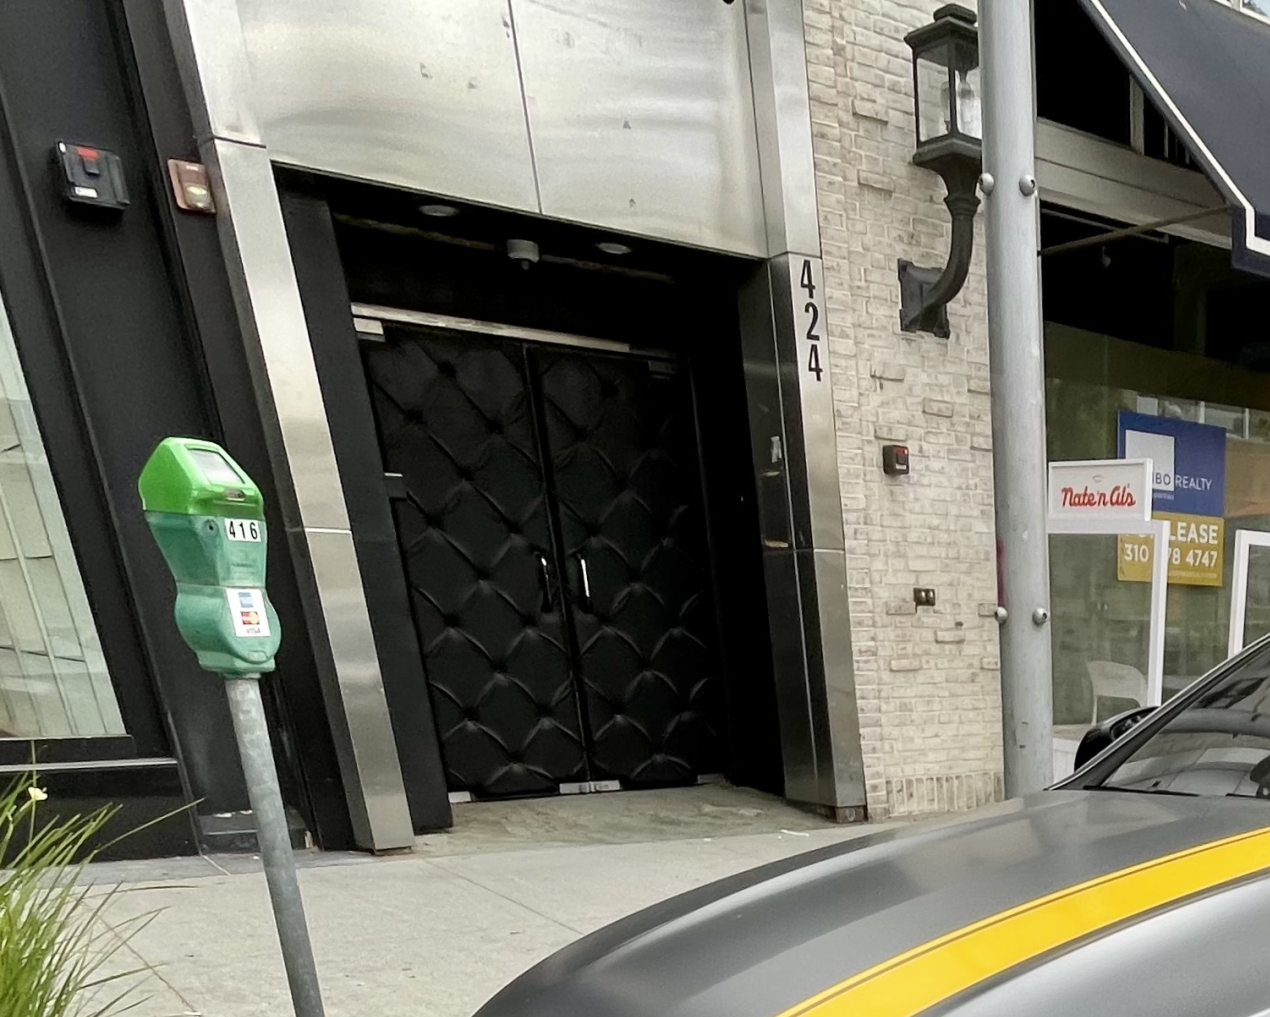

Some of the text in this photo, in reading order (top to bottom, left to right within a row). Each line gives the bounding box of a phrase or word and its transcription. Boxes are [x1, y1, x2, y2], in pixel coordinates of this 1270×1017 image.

[801, 259, 823, 382] 424
[1175, 474, 1213, 491] REALTY
[1061, 486, 1096, 507] Nate
[1109, 483, 1136, 507] Al's
[228, 521, 259, 540] 416
[1124, 543, 1149, 563] 310
[1186, 549, 1218, 568] 4747
